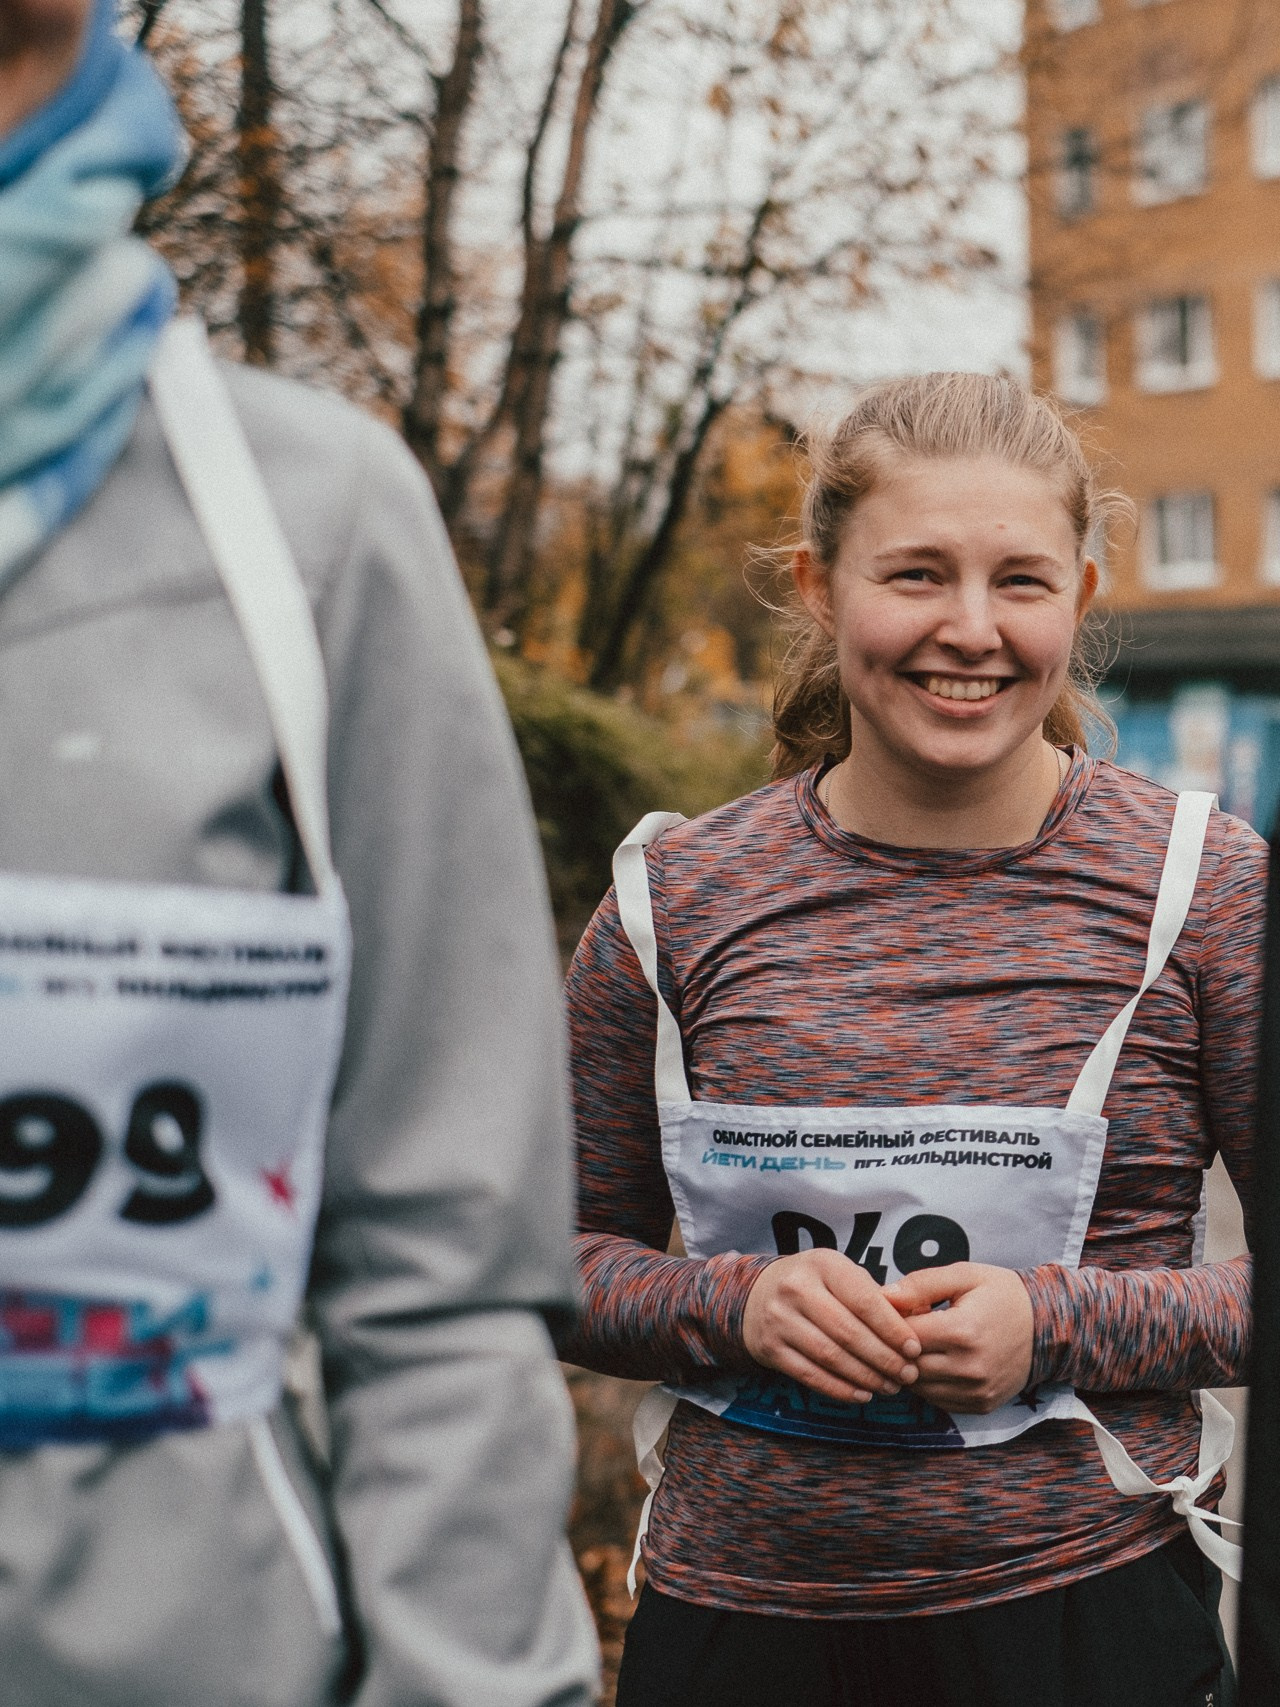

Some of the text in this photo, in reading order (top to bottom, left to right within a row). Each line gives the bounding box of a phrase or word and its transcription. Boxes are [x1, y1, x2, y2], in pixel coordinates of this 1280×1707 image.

[712, 1128, 1041, 1149] ОБЛАСТНОЙ СЕМЕЙНЫЙ ФЕСТИВАЛЬ
[701, 1148, 757, 1169] ЙЕТИ
[759, 1156, 846, 1173] ДЕНЬ
[891, 1151, 1053, 1170] КИЛЬДИНСТРОЙ
